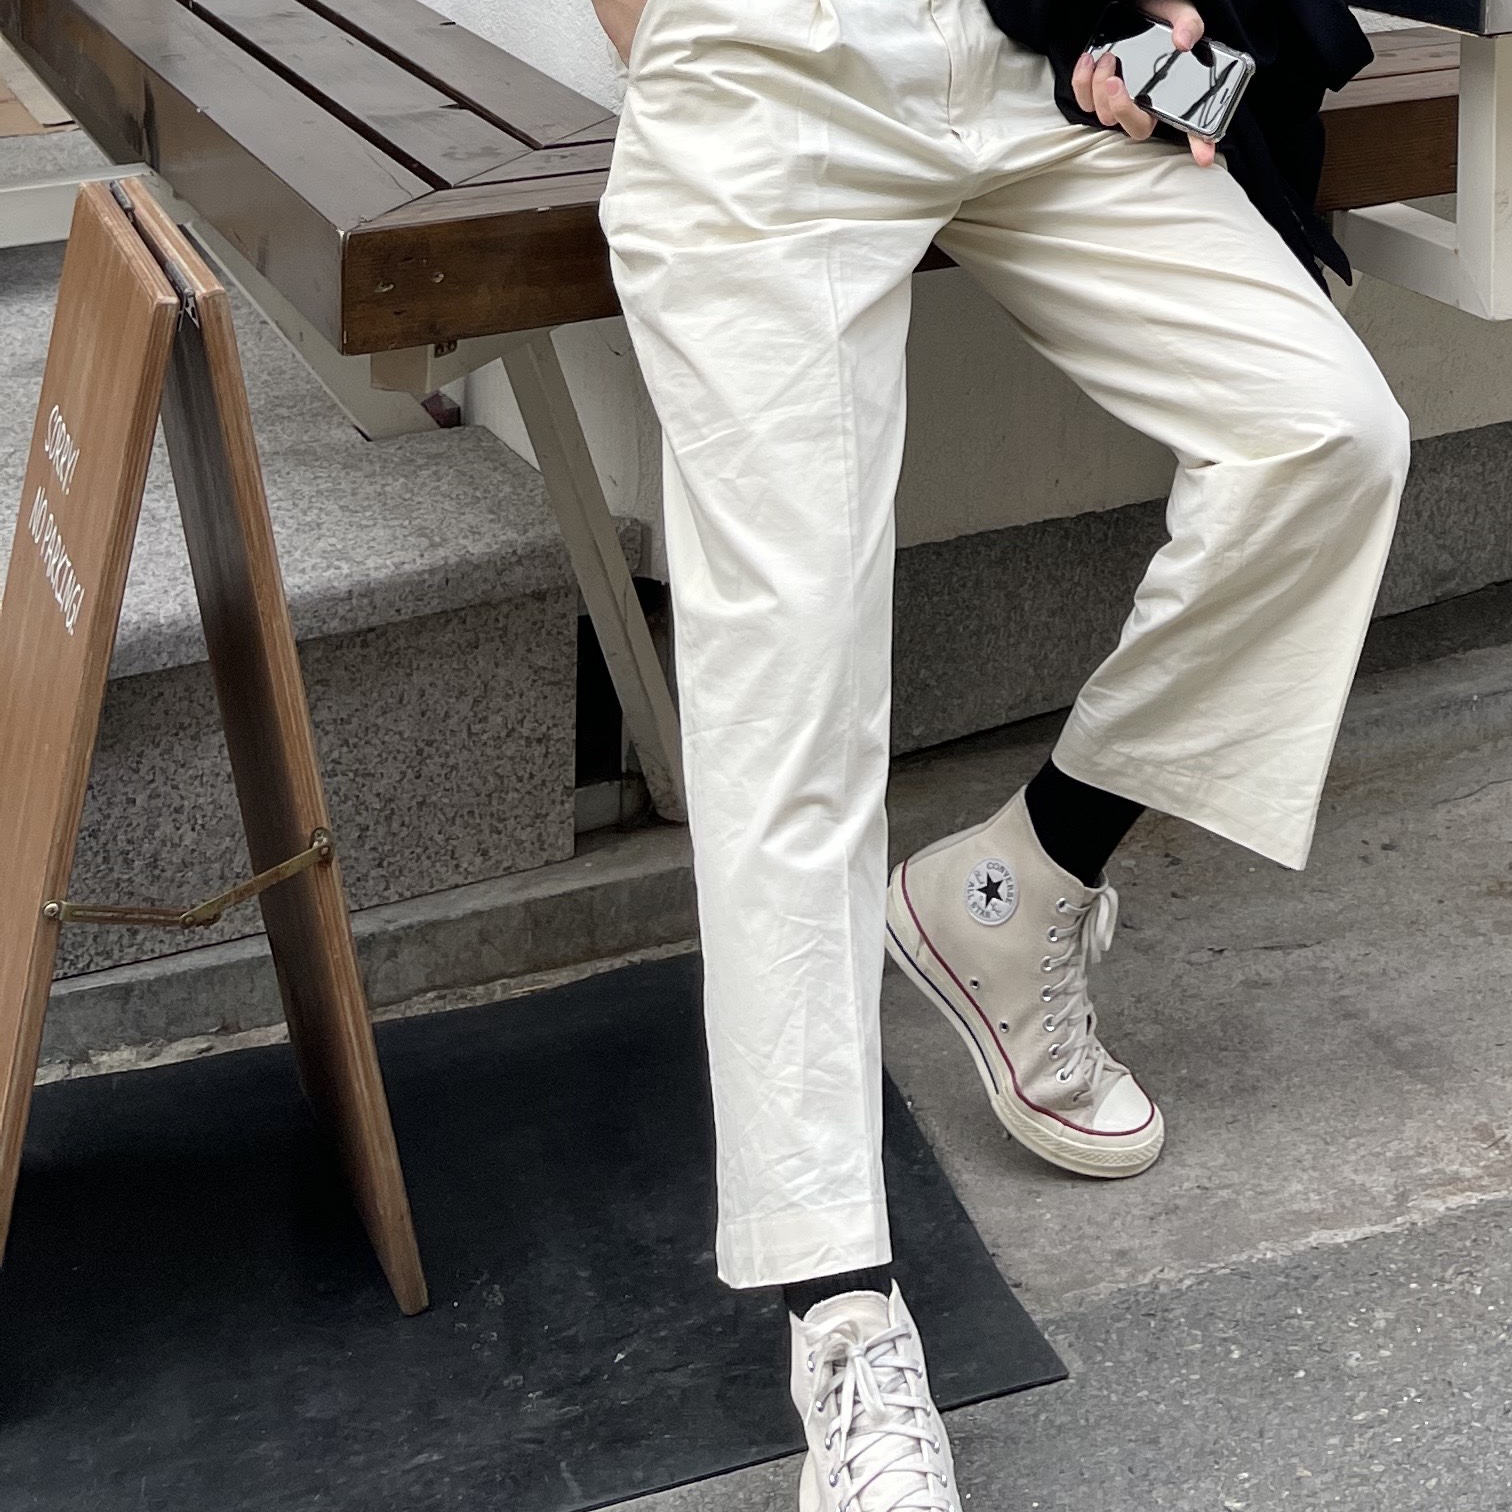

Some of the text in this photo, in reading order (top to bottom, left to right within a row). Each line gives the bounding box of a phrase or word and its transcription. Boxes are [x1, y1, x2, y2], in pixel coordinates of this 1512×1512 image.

[44, 404, 80, 496] SORRY!
[28, 485, 85, 636] NO PARKING!
[986, 862, 1014, 904] CONVERSE
